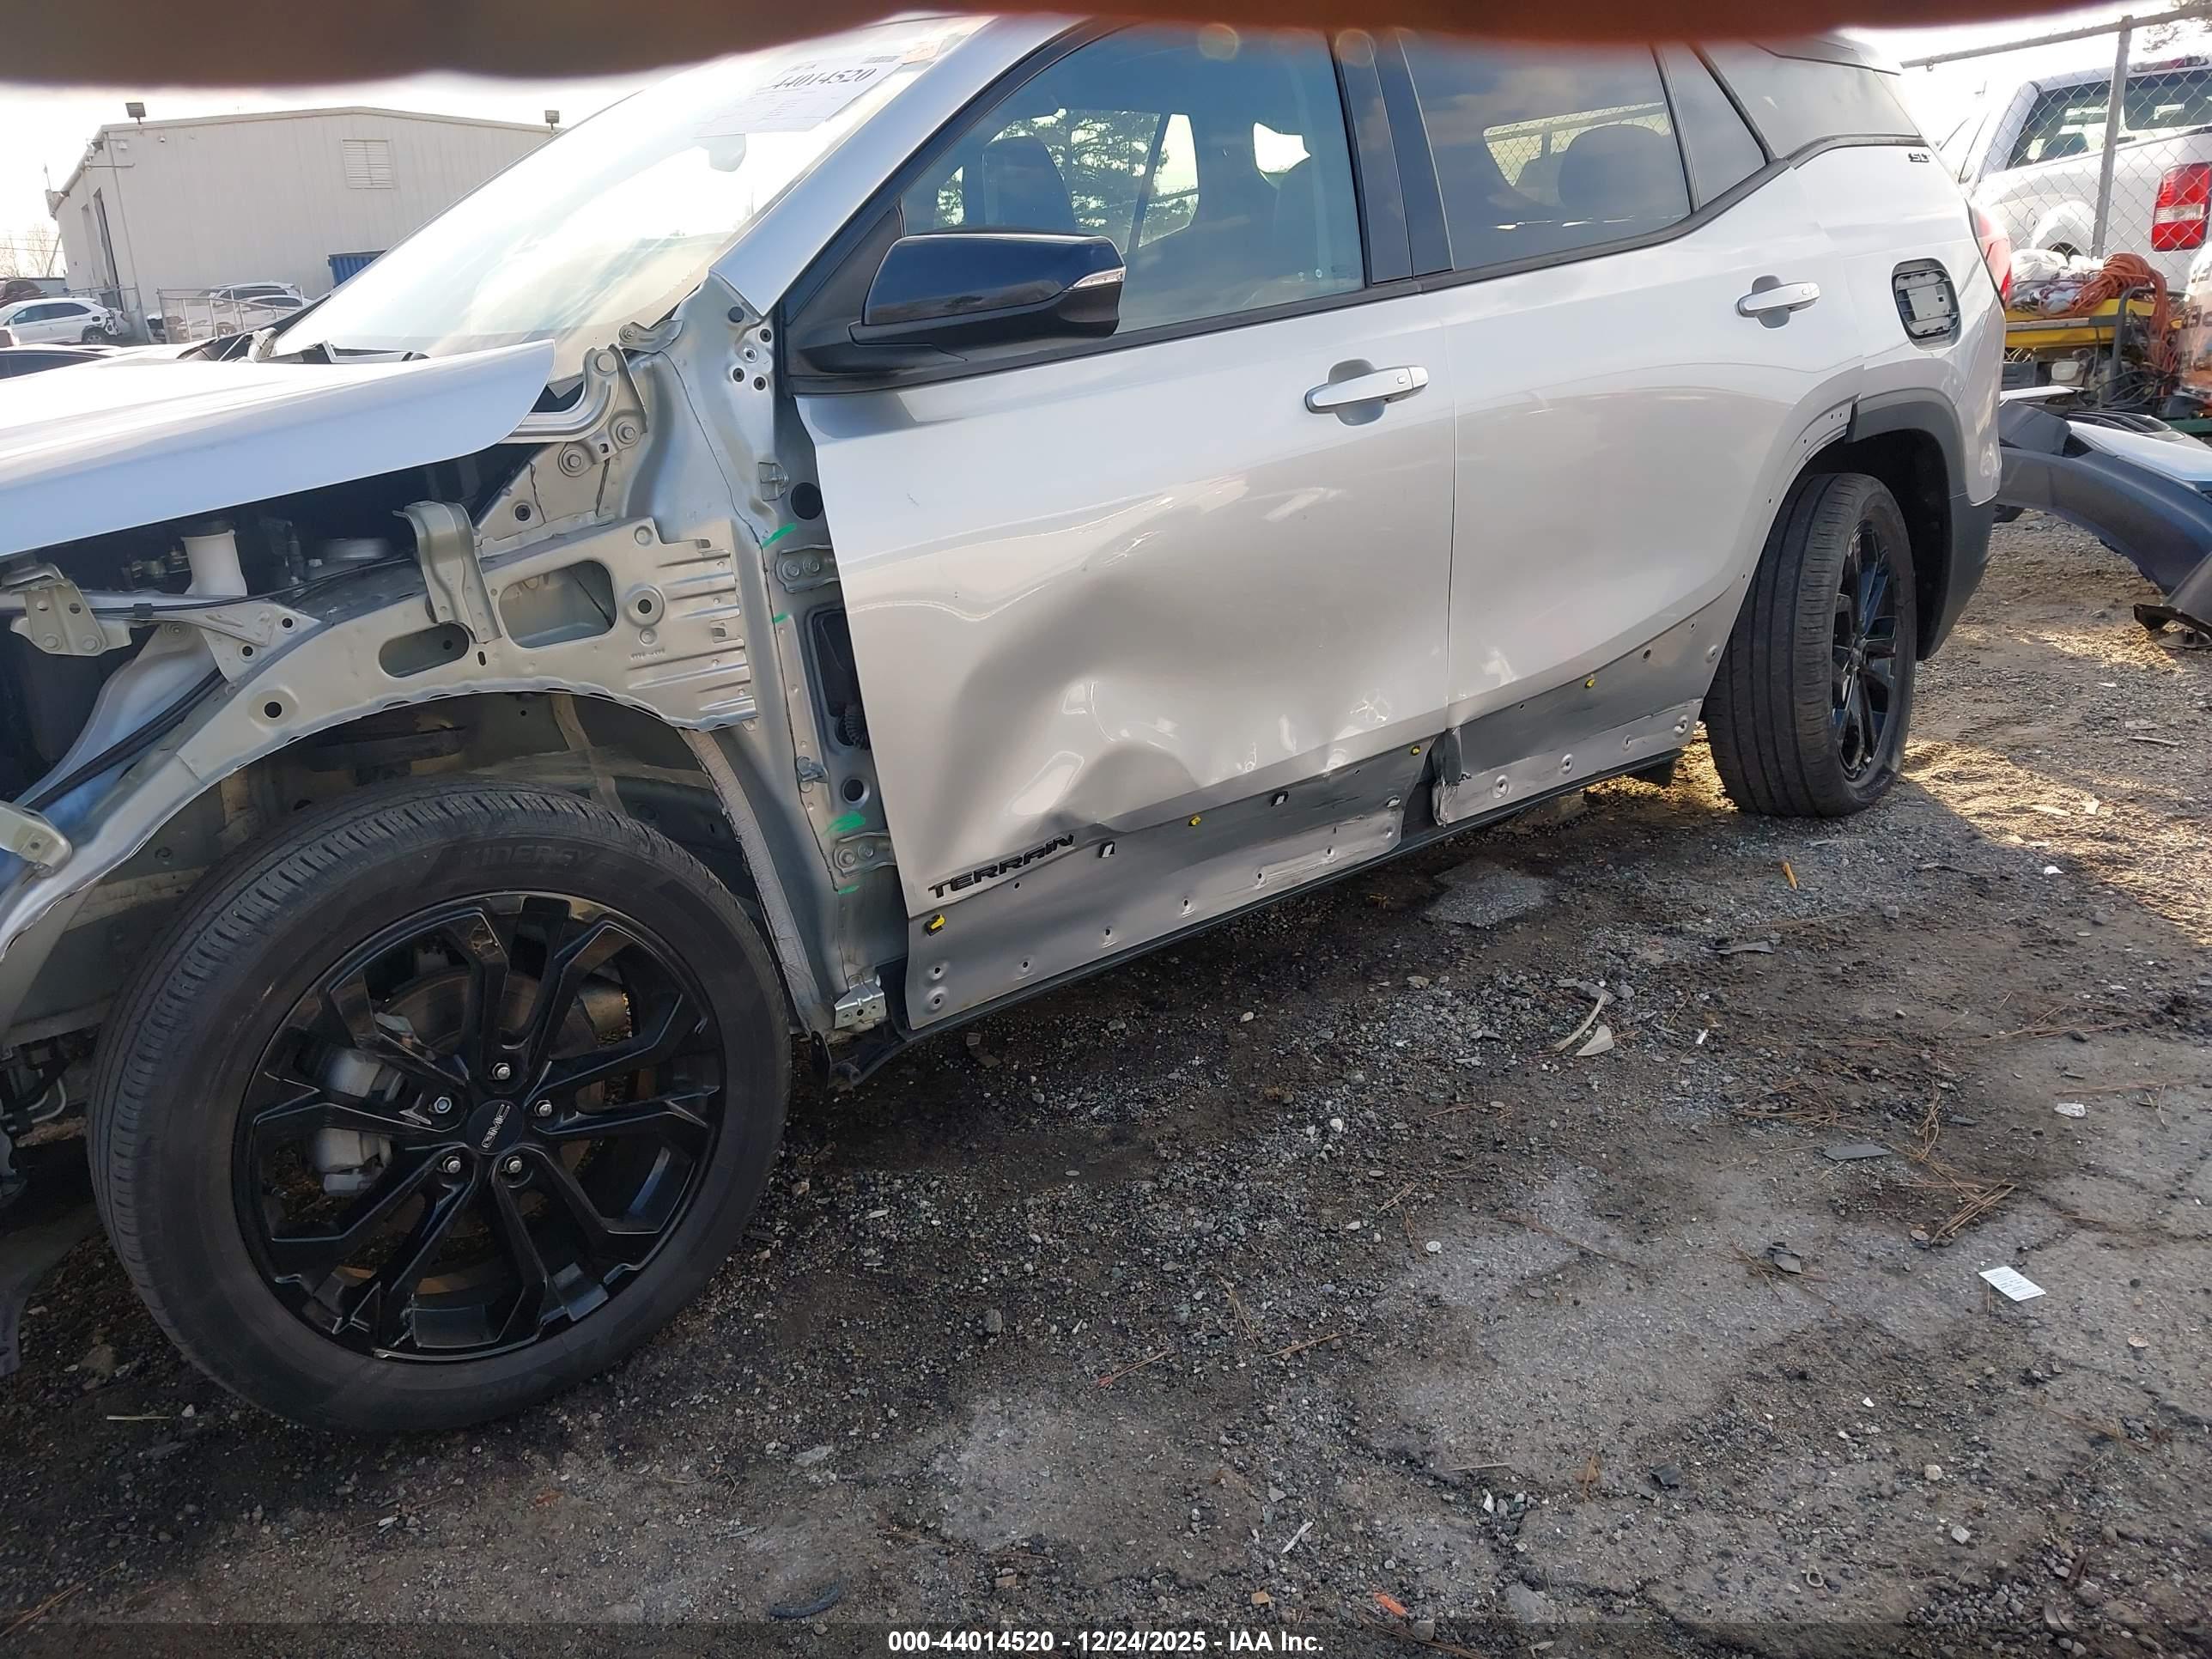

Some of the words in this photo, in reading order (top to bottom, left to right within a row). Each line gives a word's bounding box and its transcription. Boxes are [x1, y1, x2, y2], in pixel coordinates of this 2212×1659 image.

[771, 67, 879, 90] 44014520
[927, 833, 1075, 899] TERRAIN
[481, 1103, 511, 1149] GMC
